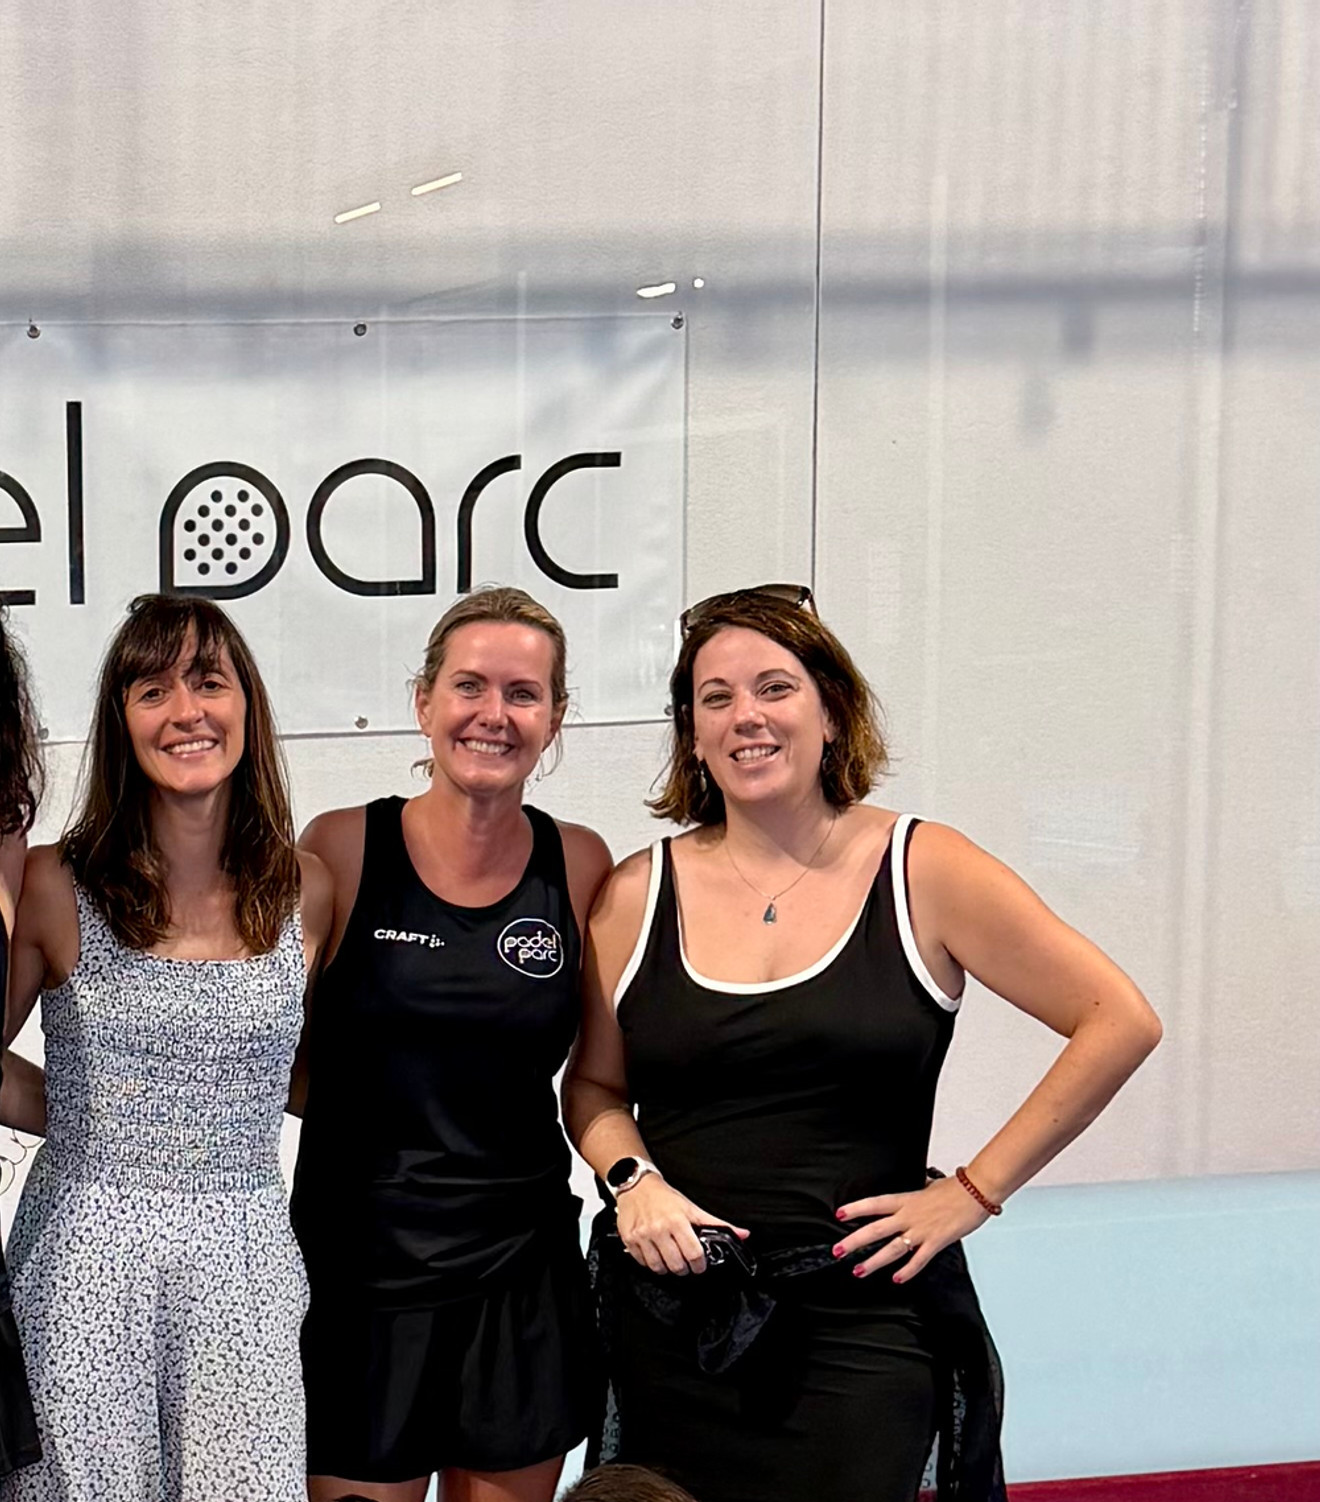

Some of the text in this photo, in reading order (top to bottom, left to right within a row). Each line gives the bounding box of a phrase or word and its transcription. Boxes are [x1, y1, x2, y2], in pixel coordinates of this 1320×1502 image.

[159, 452, 621, 600] parc
[373, 928, 430, 945] CRAFT
[504, 930, 557, 954] padel
[518, 948, 558, 965] parc
